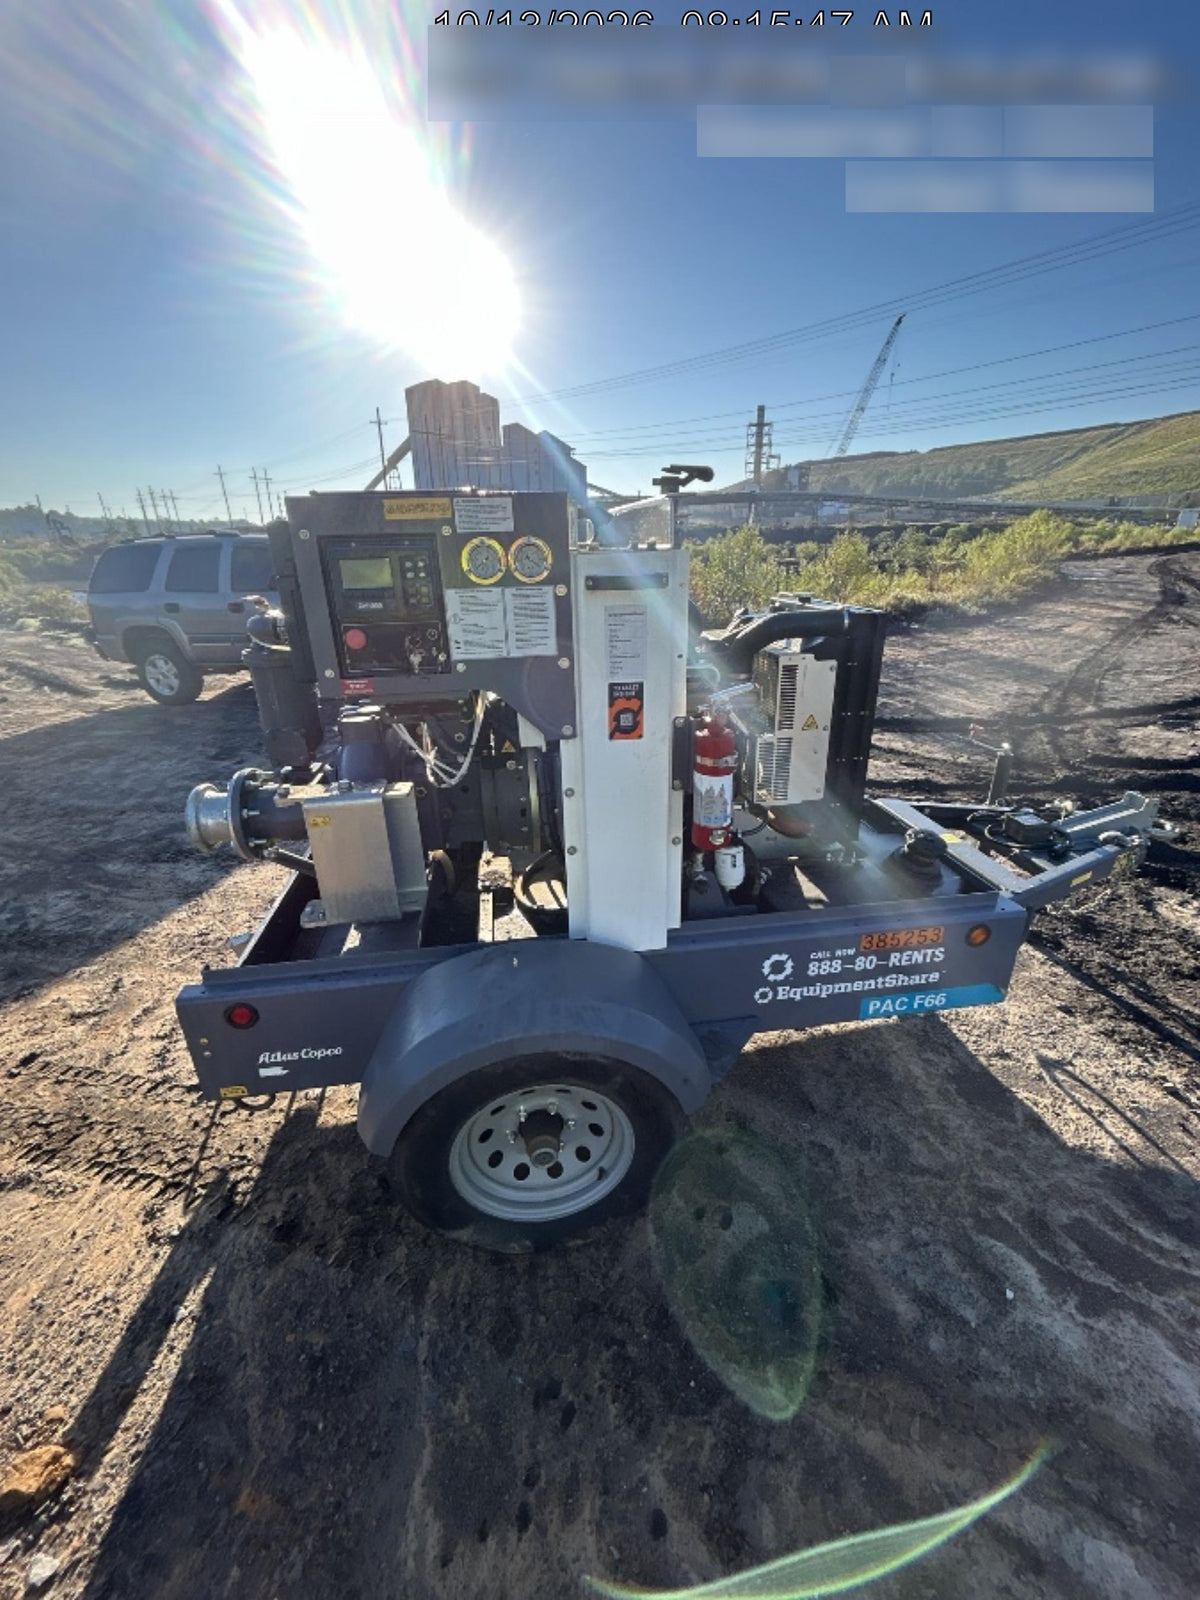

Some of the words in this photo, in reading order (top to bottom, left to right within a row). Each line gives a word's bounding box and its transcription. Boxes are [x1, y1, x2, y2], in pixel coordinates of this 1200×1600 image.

[863, 927, 942, 950] 385253
[807, 947, 945, 975] 888-80-RENTS
[810, 951, 832, 959] CALL
[776, 972, 940, 1001] EquipmentShare
[868, 997, 909, 1014] PAC
[913, 993, 947, 1009] F66
[258, 1051, 300, 1064] Atlas
[300, 1046, 342, 1060] Copco
